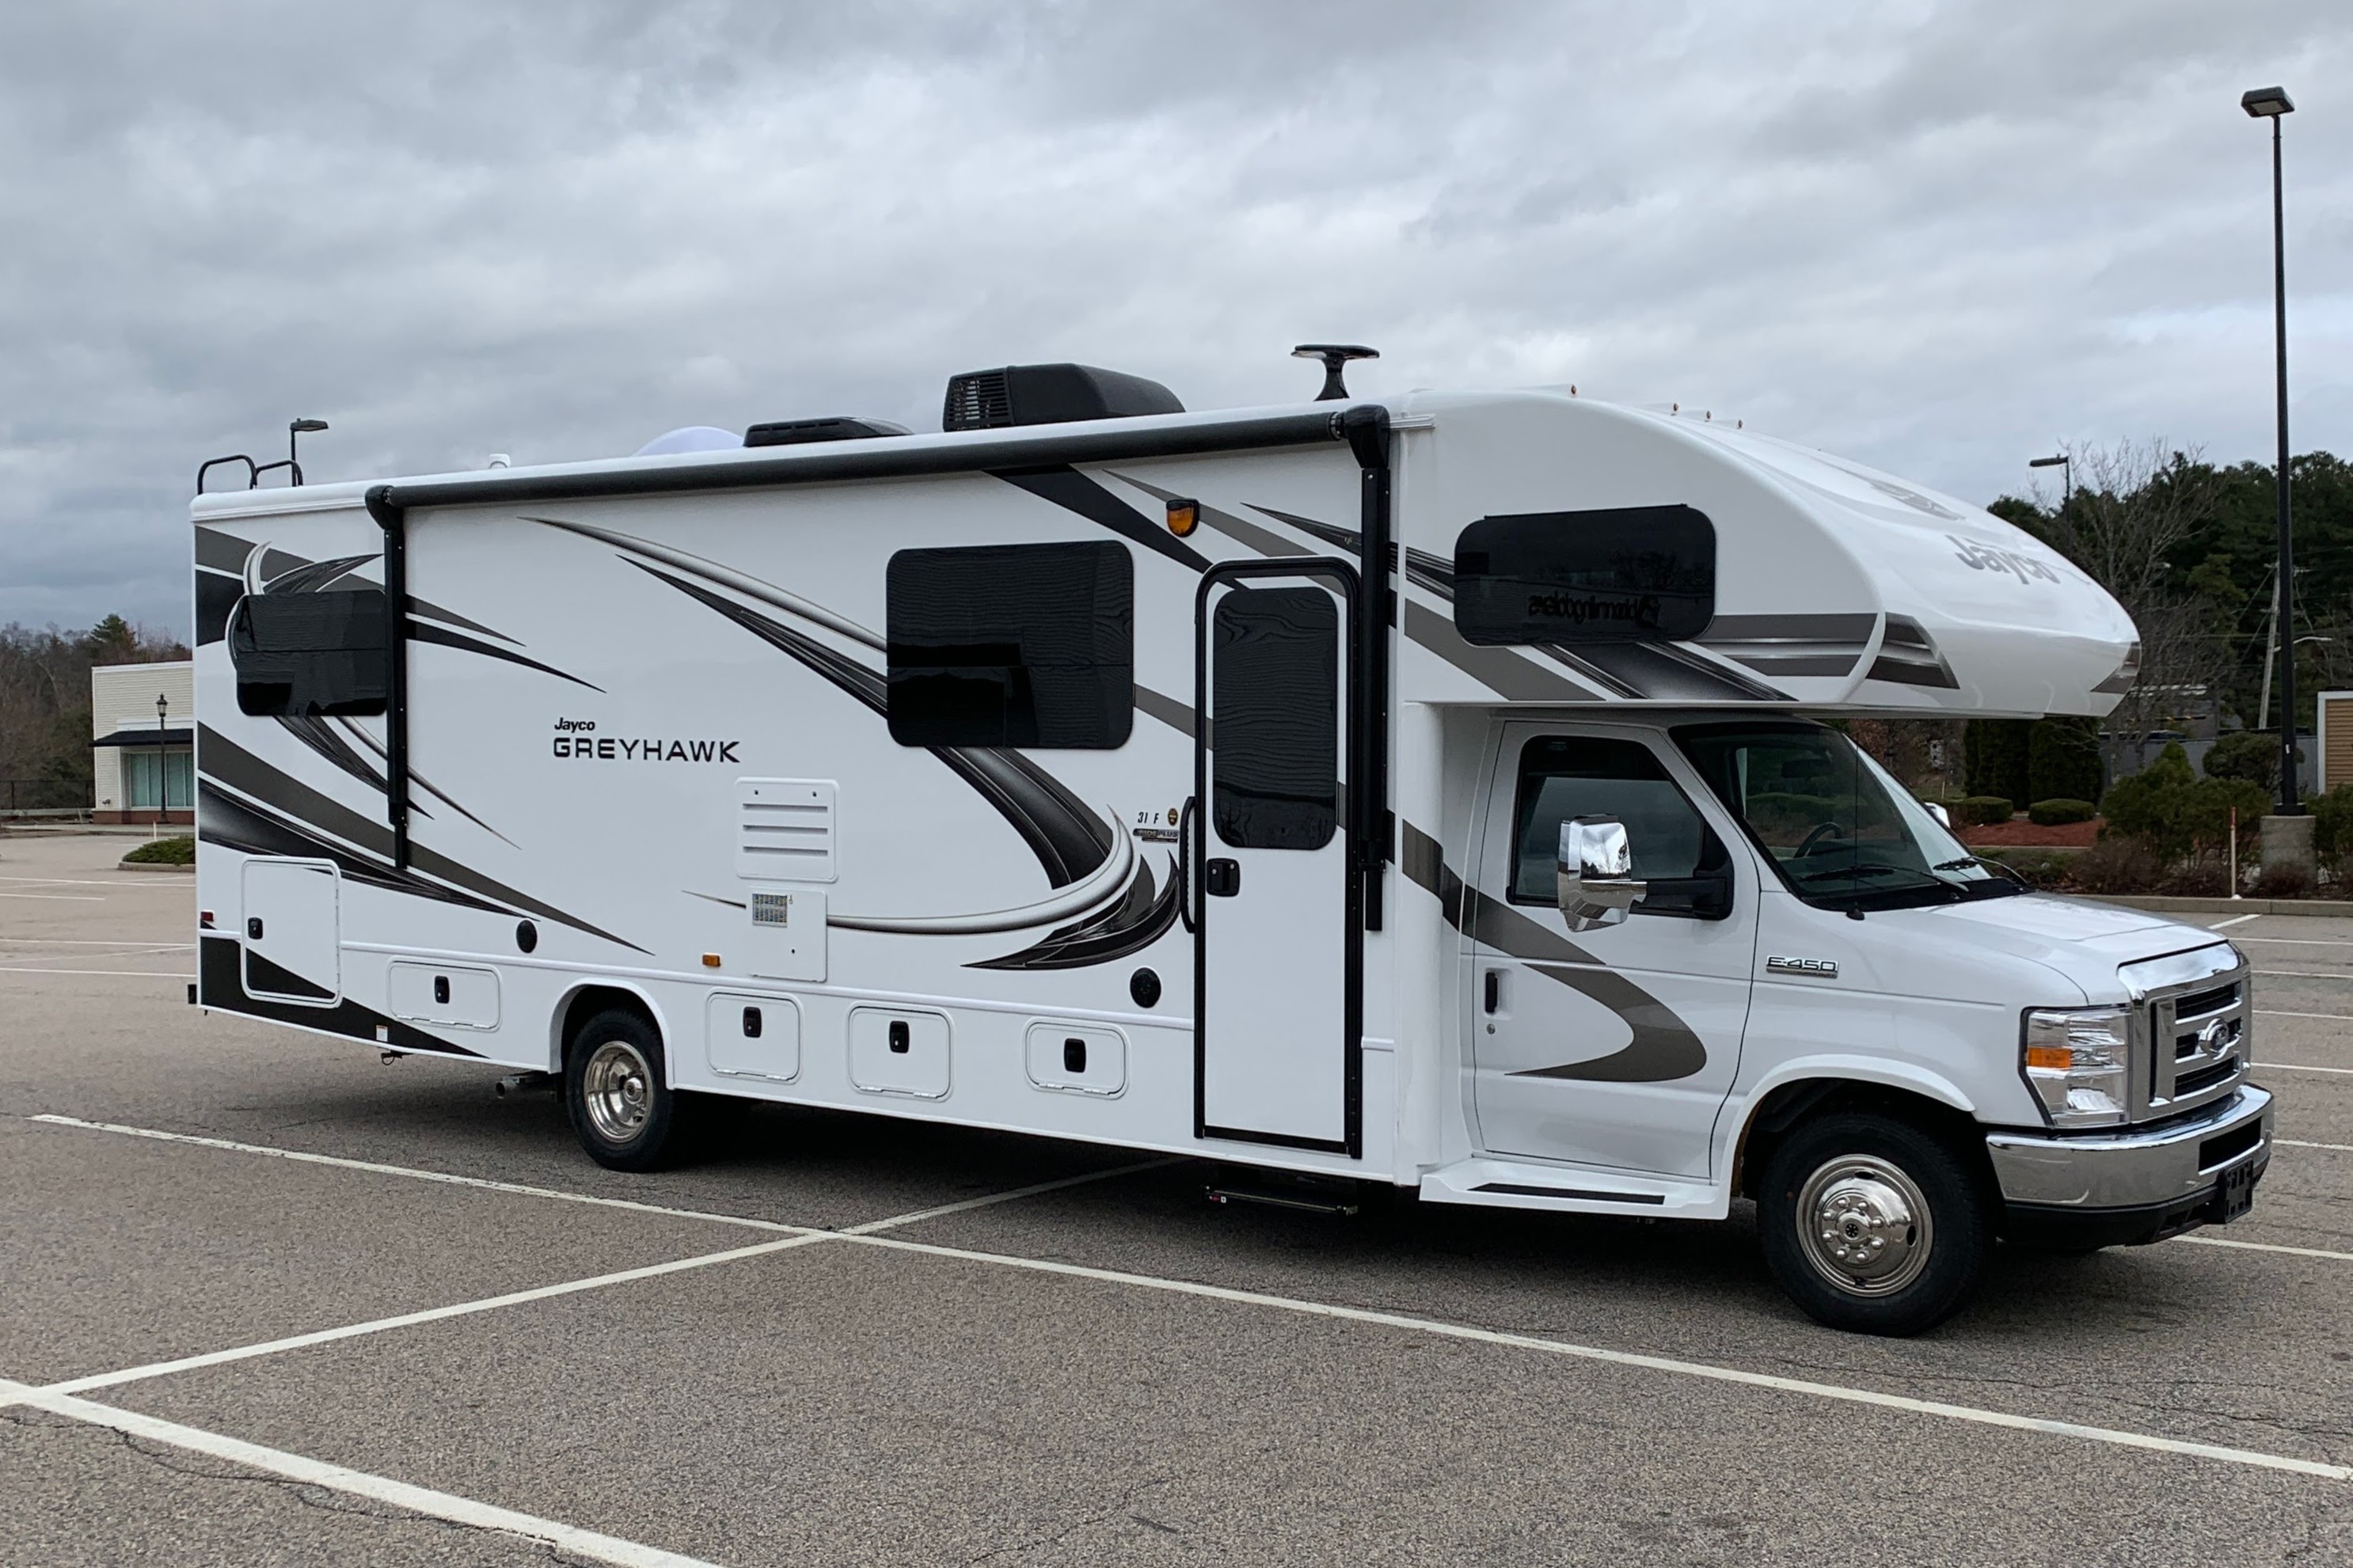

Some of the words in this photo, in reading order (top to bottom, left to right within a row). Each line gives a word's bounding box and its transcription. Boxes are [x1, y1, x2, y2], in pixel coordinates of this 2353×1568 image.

[1944, 534, 2061, 585] Jayco
[554, 717, 595, 733] Jayco
[553, 737, 741, 763] GREYHAWK
[1767, 955, 1837, 972] E-450
